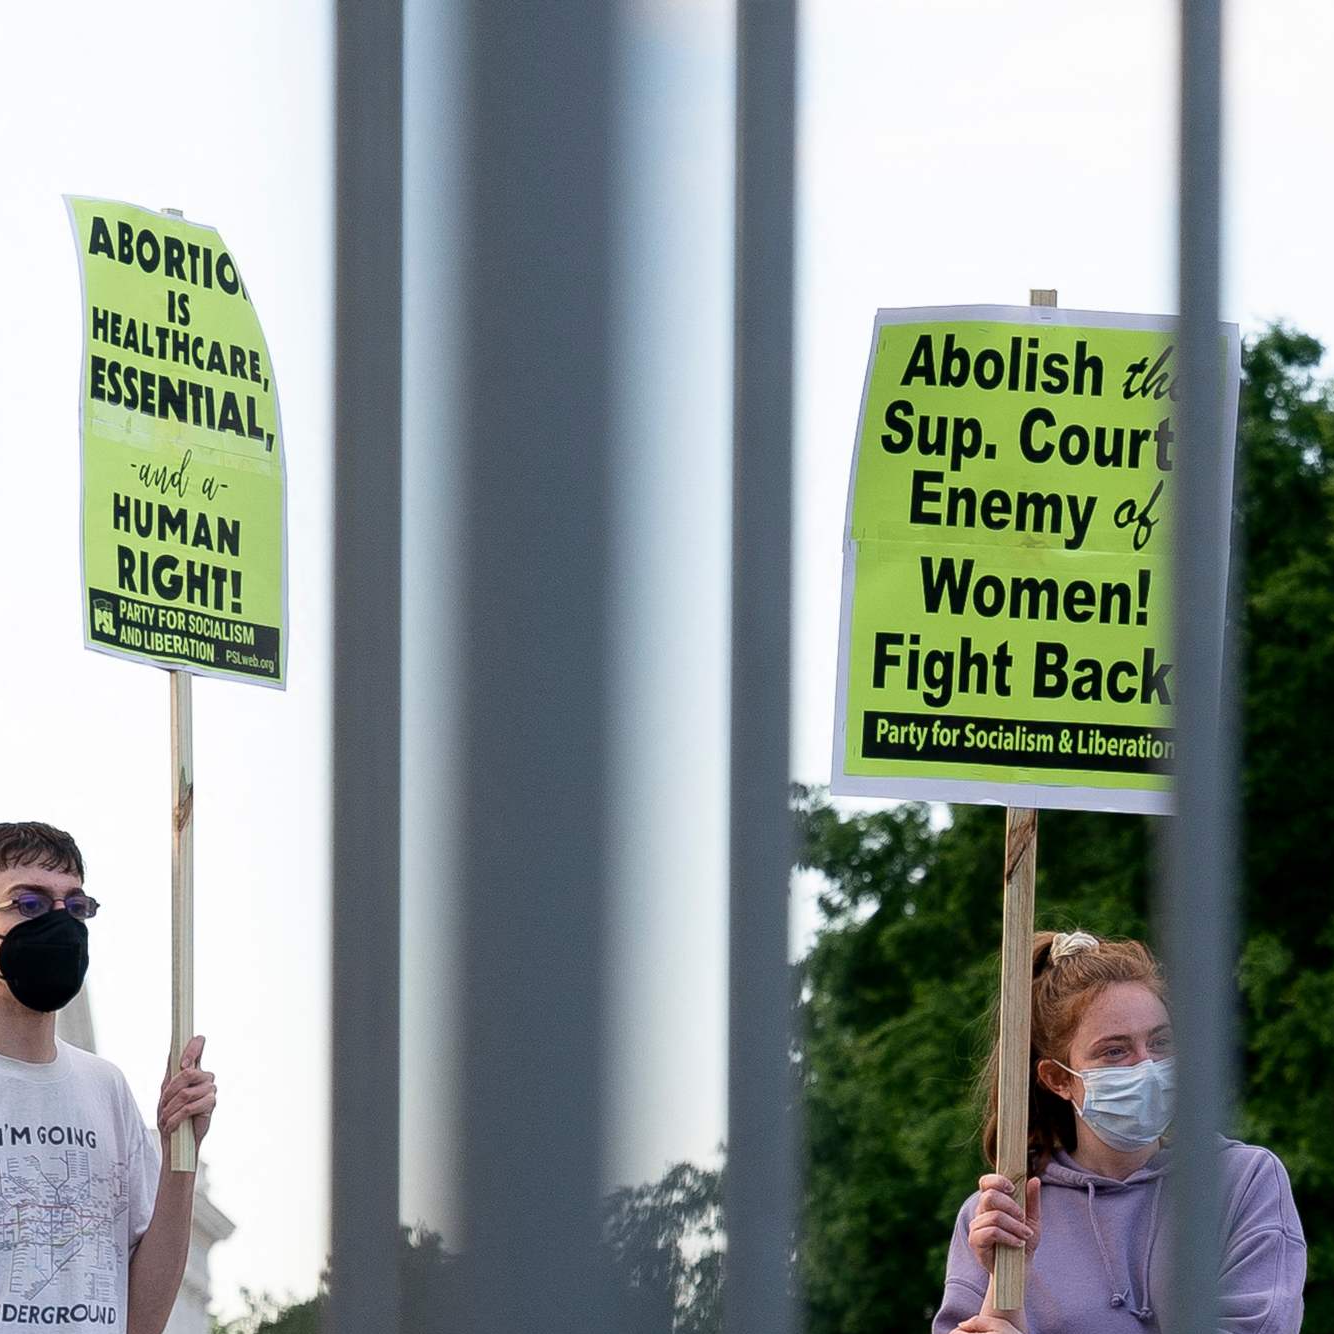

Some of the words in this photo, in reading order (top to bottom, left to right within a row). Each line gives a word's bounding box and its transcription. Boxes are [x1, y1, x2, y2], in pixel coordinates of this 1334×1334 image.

[88, 216, 247, 301] ABORTIO
[167, 290, 190, 326] IS
[91, 306, 269, 393] HEALTHCARE,
[900, 333, 1104, 397] Abolish
[90, 354, 274, 452] ESSENTIAL,
[880, 399, 997, 472] Sup.
[1019, 407, 1174, 471] Court
[113, 492, 240, 557] HUMAN
[909, 470, 1098, 550] Enemy
[1113, 479, 1165, 551] of
[117, 544, 242, 614] RIGHT!
[920, 556, 1152, 626] Women!
[94, 608, 116, 636] PSL
[119, 600, 155, 626] PARTY
[158, 609, 186, 631] FOR
[188, 617, 255, 646] SOCIALISM
[119, 625, 142, 648] AND
[143, 629, 215, 662] LIBERATION
[225, 649, 275, 673] PSLweb.org
[872, 632, 1014, 708] Fight
[1032, 641, 1175, 706] Back
[876, 718, 928, 752] Party
[932, 721, 960, 748] for
[964, 723, 1054, 754] Socialism
[1059, 728, 1073, 754] &
[1077, 729, 1175, 761] Liberation
[37, 1126, 97, 1148] GOING
